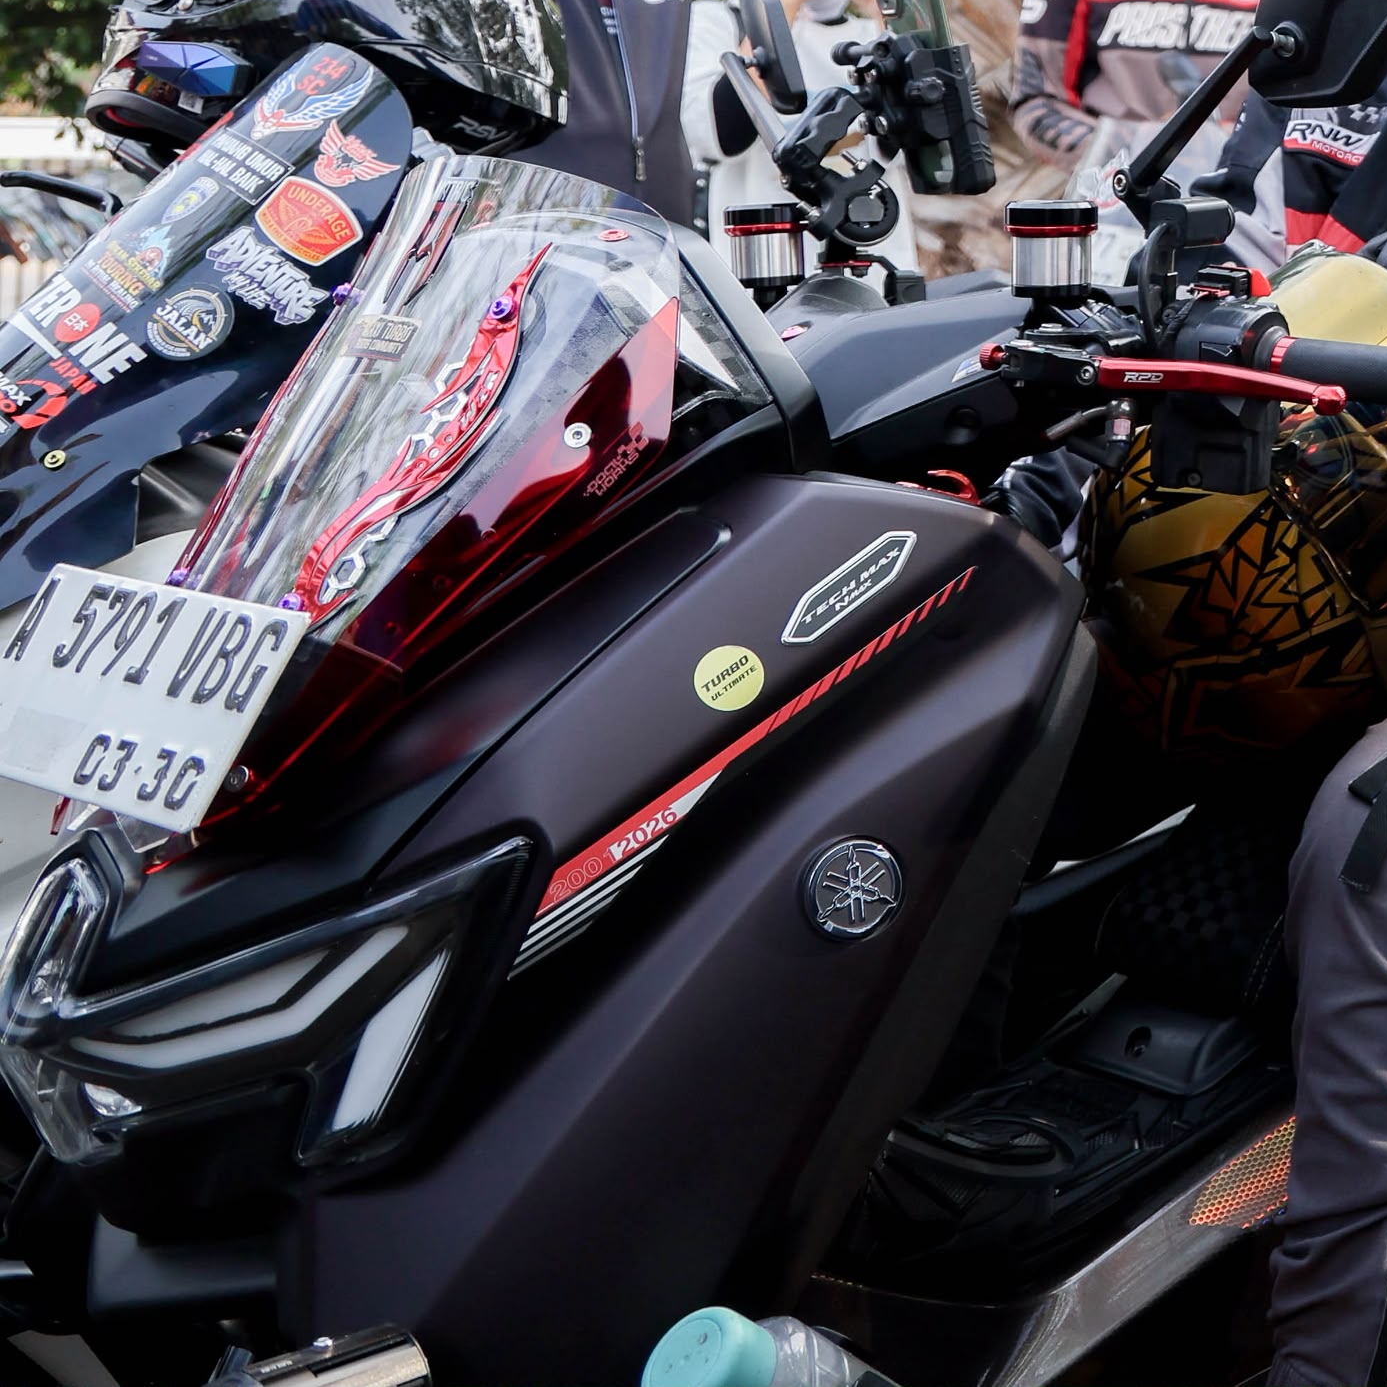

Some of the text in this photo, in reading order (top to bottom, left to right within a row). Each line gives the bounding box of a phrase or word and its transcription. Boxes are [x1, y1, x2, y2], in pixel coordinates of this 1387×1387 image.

[296, 74, 326, 95] SC
[312, 56, 348, 81] 234
[1286, 122, 1364, 147] RNW
[229, 167, 264, 193] BAIK
[245, 151, 285, 182] UMUR
[287, 185, 350, 240] UNDERAGE
[97, 253, 144, 296] TOURING
[206, 225, 330, 324] ADVENTURE
[156, 304, 213, 349] JALAN
[49, 356, 98, 395] JAPAN
[1123, 372, 1164, 383] RPD
[800, 547, 900, 624] TECH MAX
[2, 578, 288, 713] A 5791 VBG
[701, 654, 749, 695] TURBO
[711, 664, 758, 702] ULTIMATE
